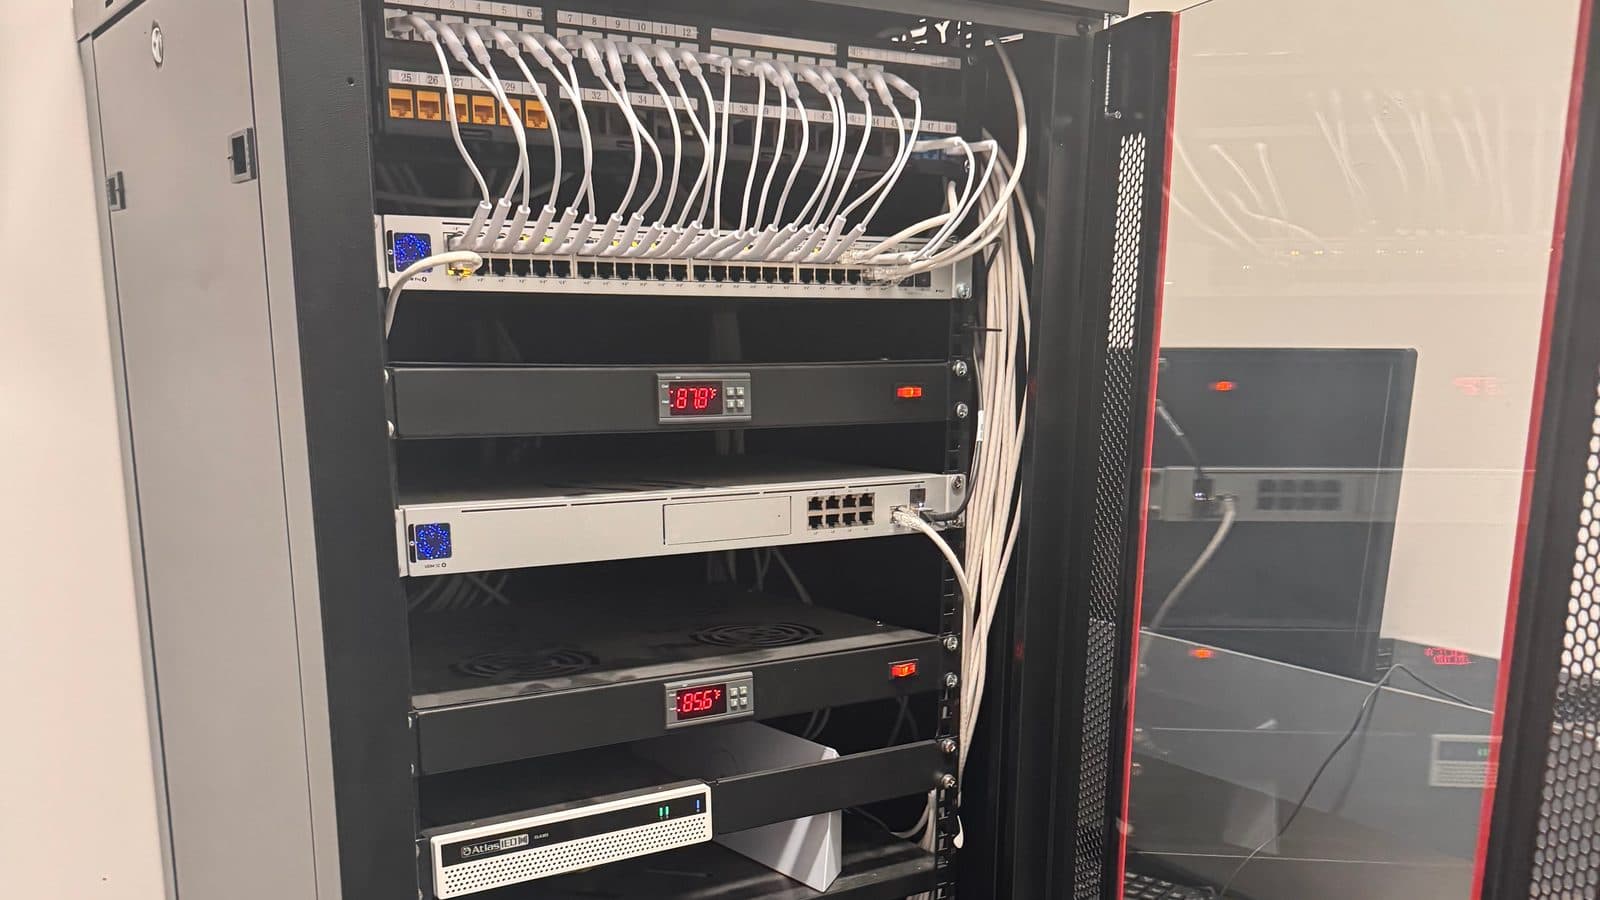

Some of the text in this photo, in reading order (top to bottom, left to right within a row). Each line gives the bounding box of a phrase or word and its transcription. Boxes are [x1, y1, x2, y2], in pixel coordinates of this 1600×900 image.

[637, 22, 646, 31] 10
[660, 25, 668, 34] 11
[682, 28, 691, 36] 12
[401, 73, 516, 91] 25 26 27 29
[591, 91, 601, 100] 32
